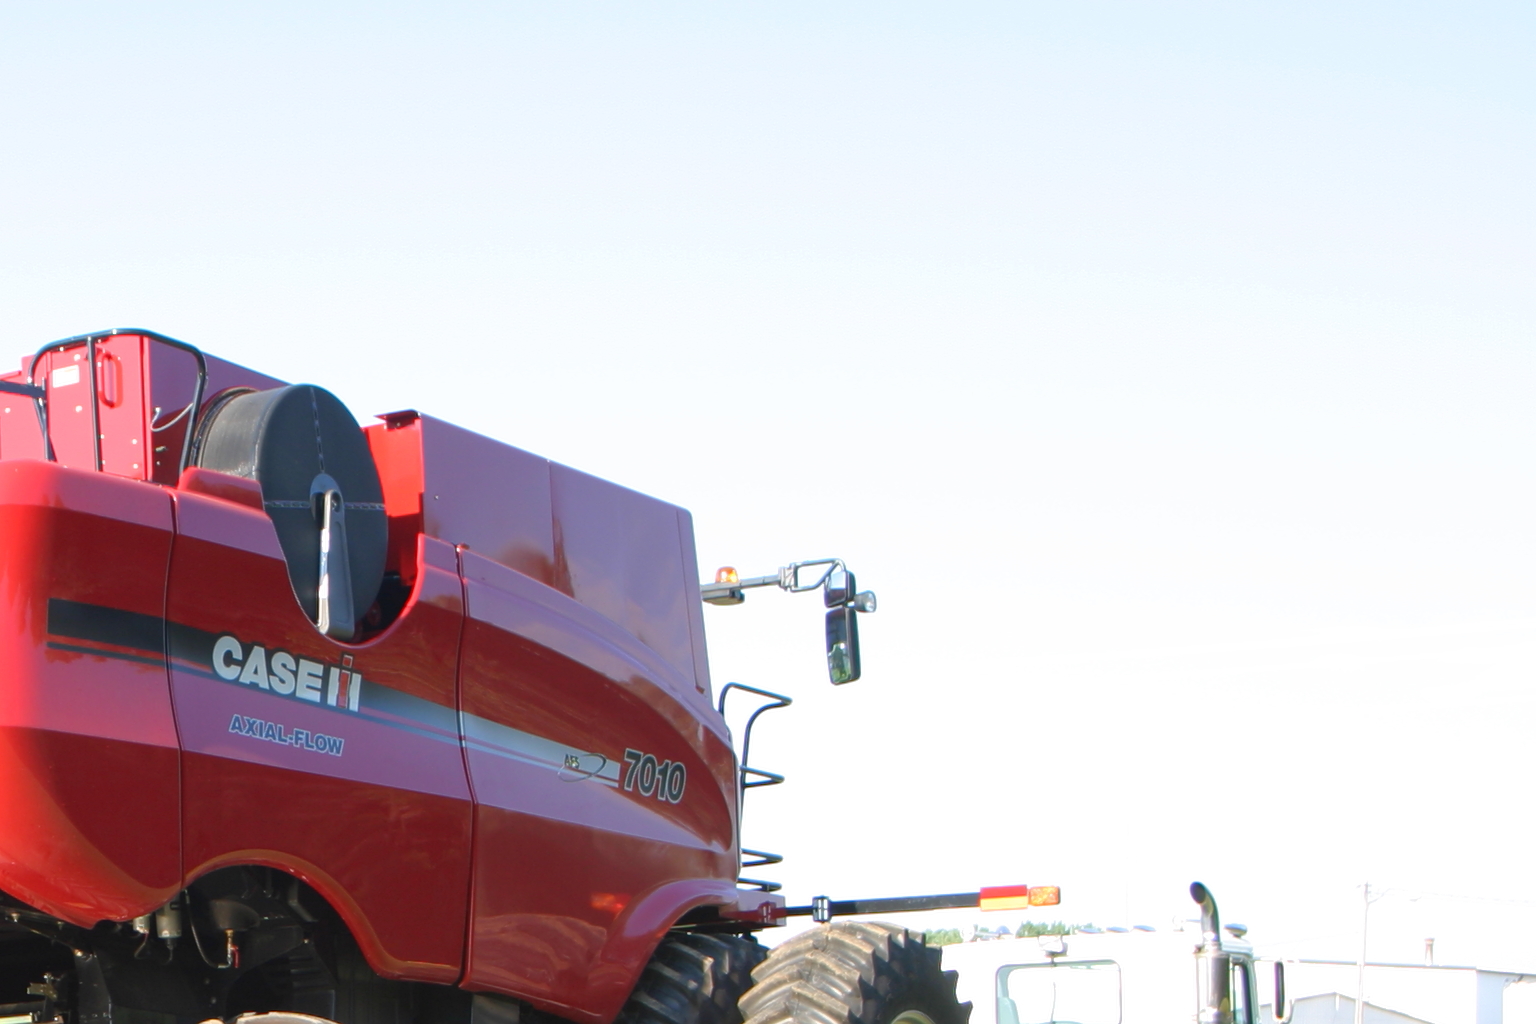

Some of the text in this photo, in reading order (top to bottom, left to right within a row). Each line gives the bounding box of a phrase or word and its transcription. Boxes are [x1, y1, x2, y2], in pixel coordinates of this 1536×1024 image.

[212, 635, 325, 703] CASE
[229, 713, 345, 757] AXIAL-FLOW
[623, 747, 686, 804] 7010
